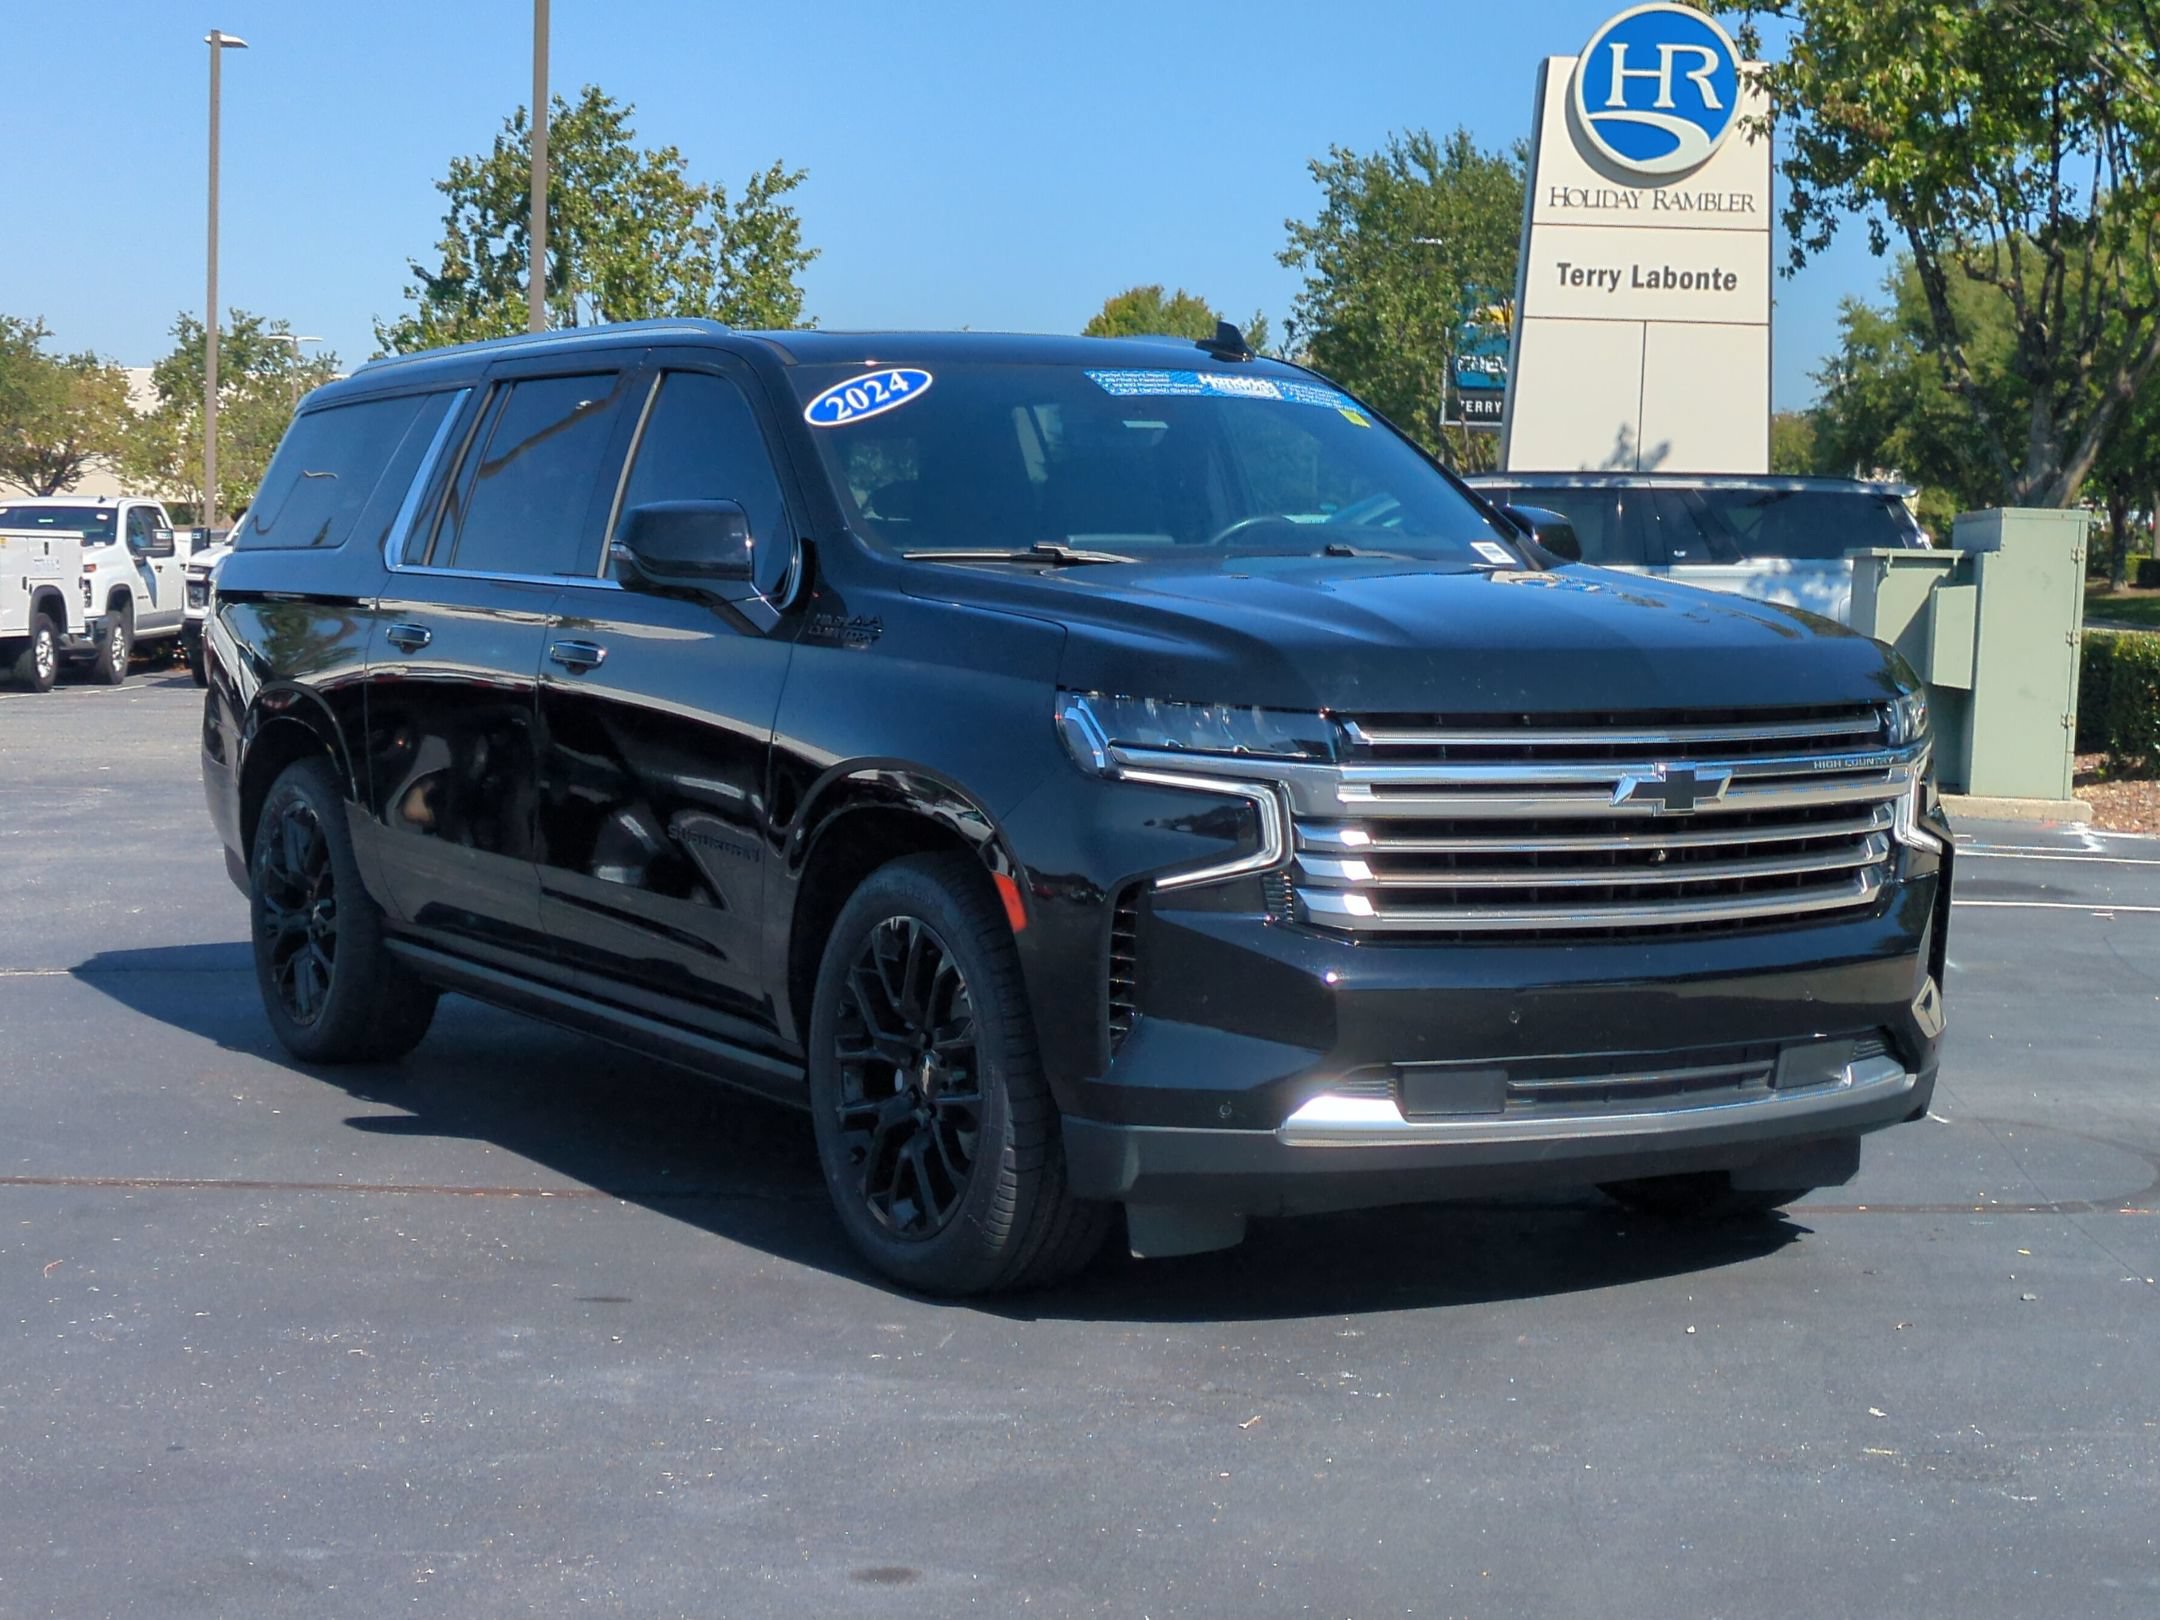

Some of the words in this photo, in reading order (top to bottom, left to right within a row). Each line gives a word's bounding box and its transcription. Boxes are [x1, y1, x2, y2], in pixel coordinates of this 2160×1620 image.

[1604, 43, 1723, 109] HR
[1549, 186, 1643, 210] HOLIDAY
[1652, 189, 1756, 213] RAMBLER
[1556, 262, 1622, 293] Terry
[1631, 264, 1738, 291] Labonte
[825, 371, 909, 420] 2024
[1460, 400, 1502, 413] ERRY
